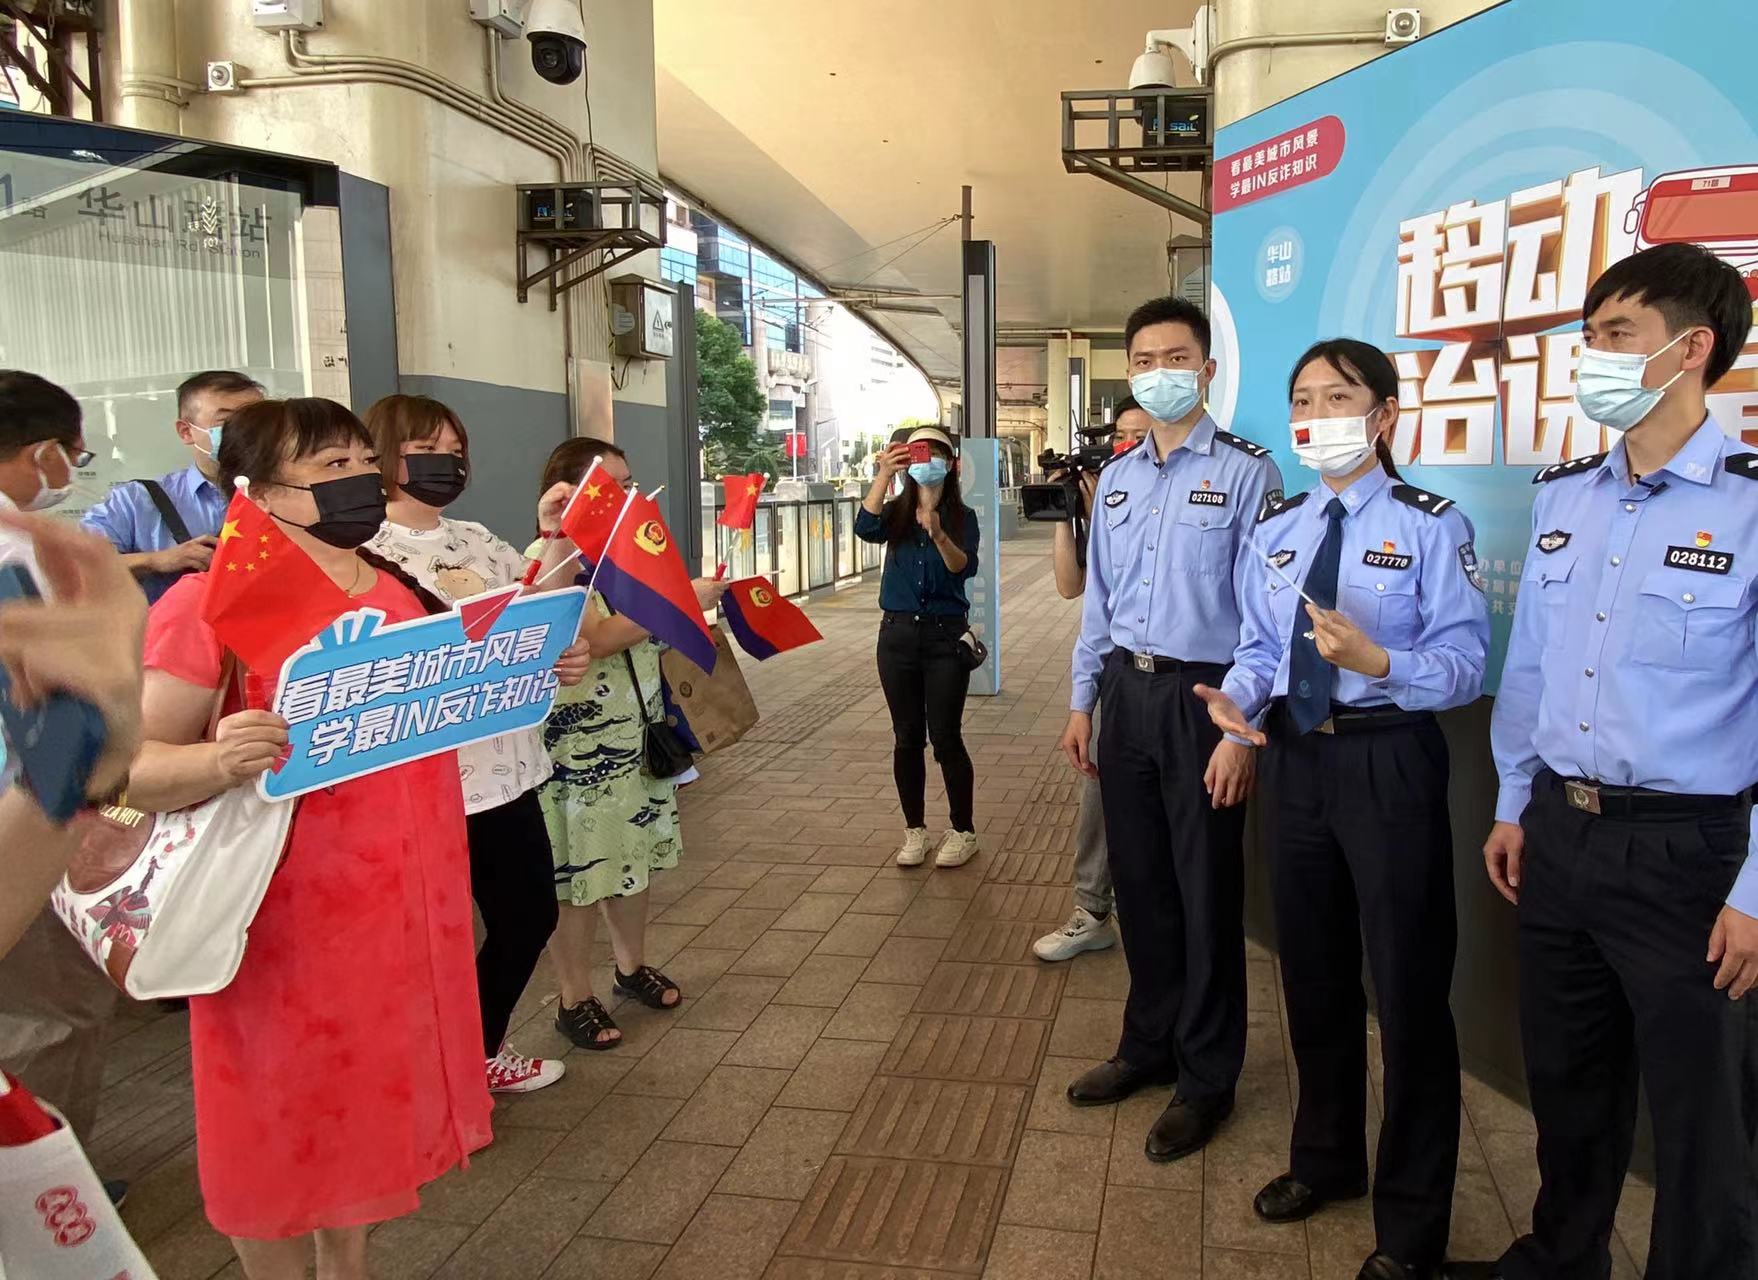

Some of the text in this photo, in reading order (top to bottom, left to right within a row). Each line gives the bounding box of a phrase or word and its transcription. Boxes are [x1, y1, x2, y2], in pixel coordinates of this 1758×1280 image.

[1230, 128, 1319, 177] 看最美城市风景
[1230, 153, 1318, 199] 学最IN反诈知识
[1267, 241, 1292, 263] 华山
[1395, 165, 1643, 338] 移动
[1191, 492, 1224, 504] 027108
[1670, 550, 1728, 571] 028112
[279, 623, 551, 724] 看最美城市风景
[306, 668, 560, 768] 学最IN反诈知识
